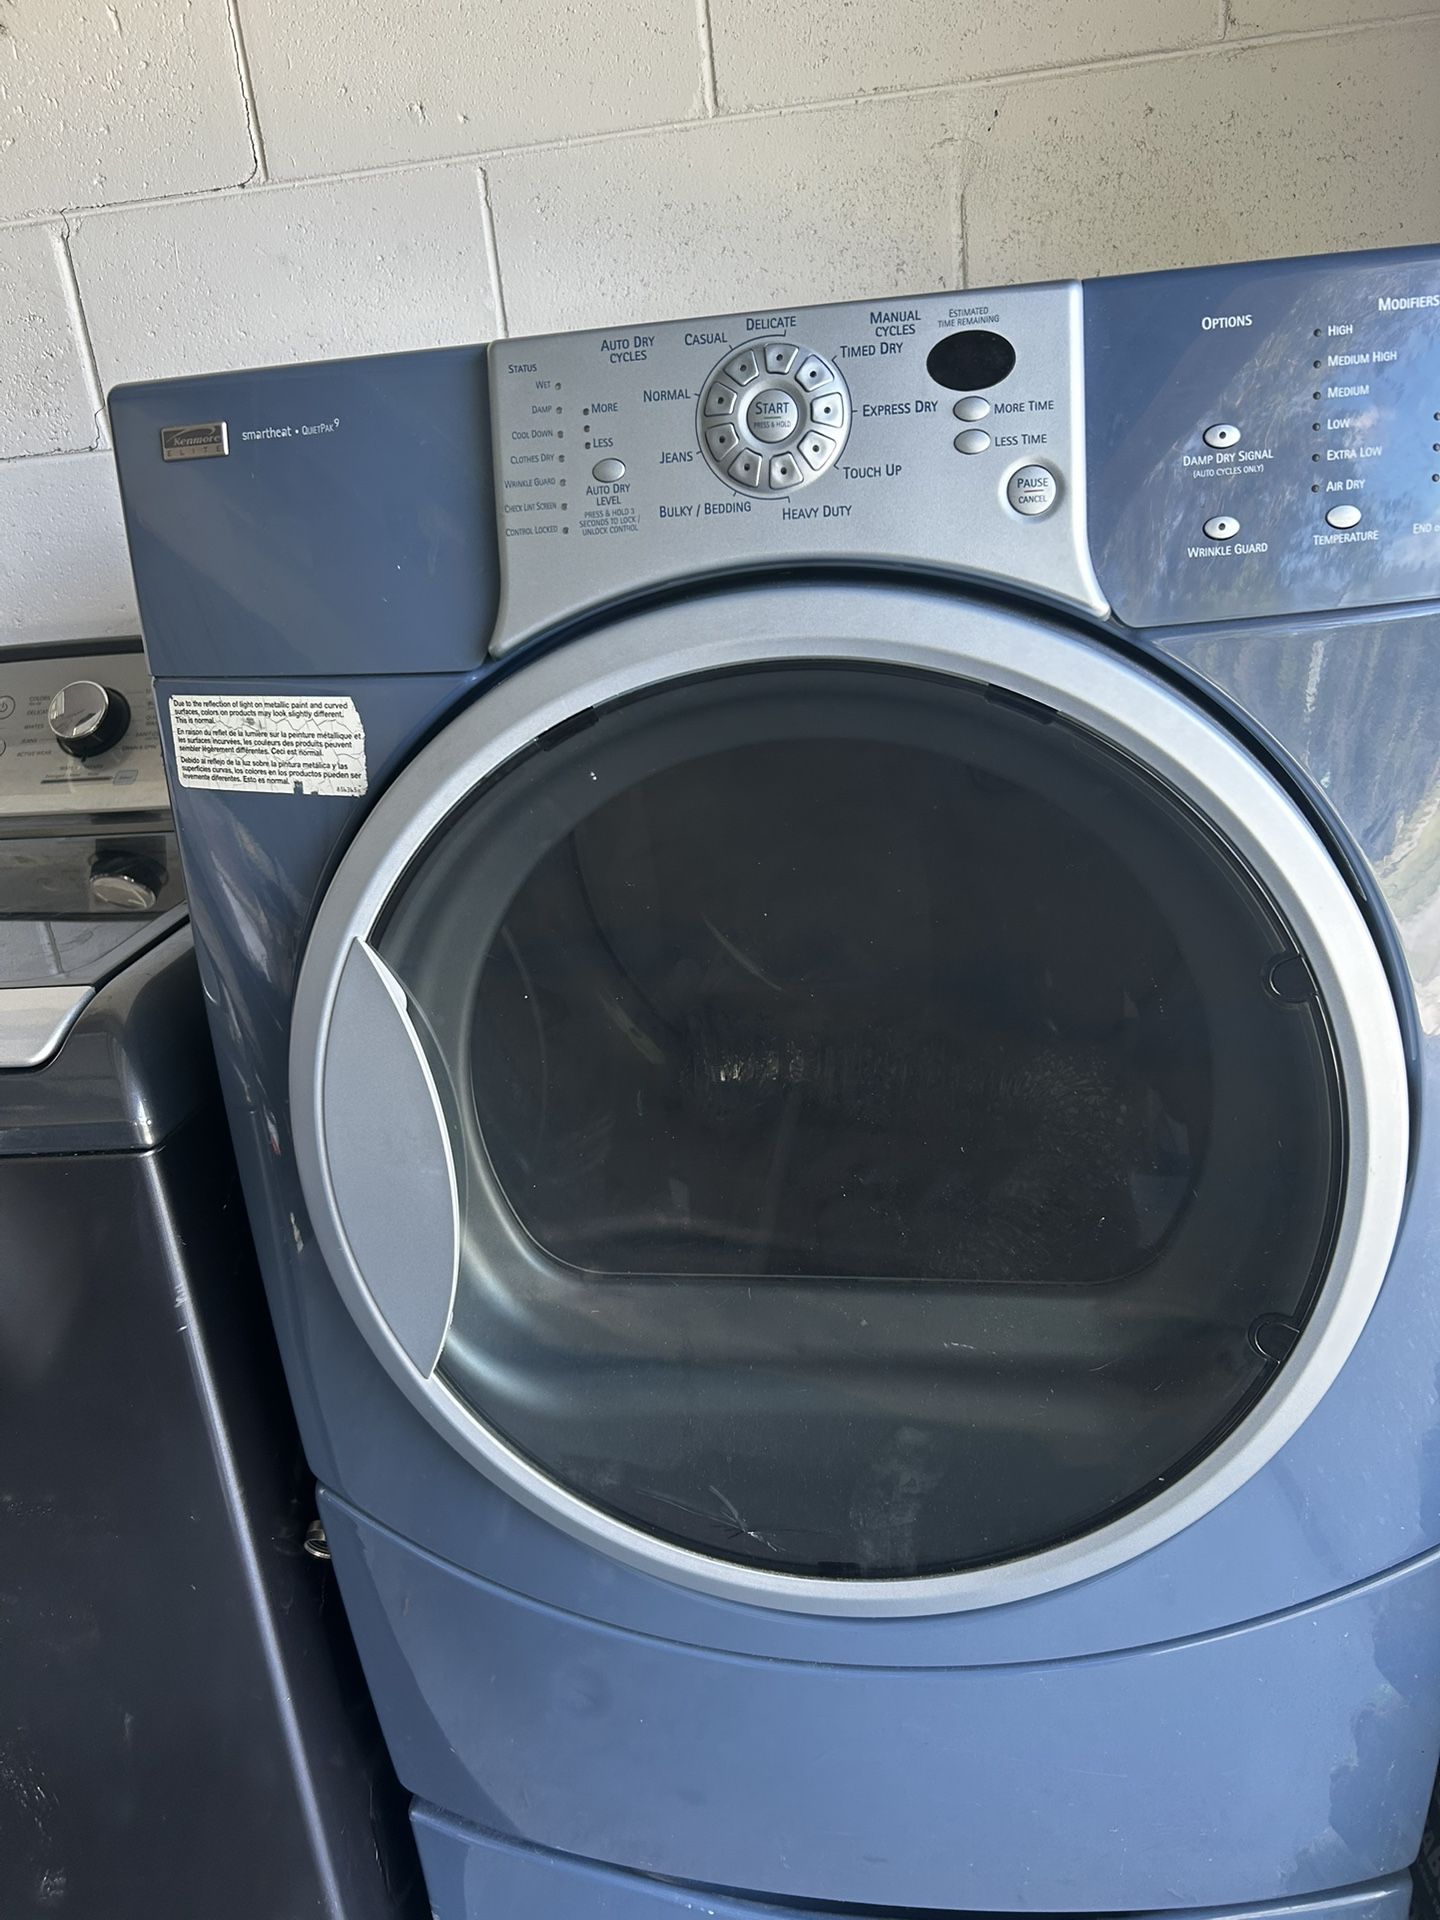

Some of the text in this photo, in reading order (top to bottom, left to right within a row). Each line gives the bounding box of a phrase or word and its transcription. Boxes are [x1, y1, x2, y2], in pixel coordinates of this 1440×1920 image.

[1378, 295, 1440, 311] MODIFIERS
[870, 310, 921, 324] MANUAL
[949, 307, 988, 318] ESTIMATED
[746, 316, 797, 331] DELICATE
[938, 314, 1000, 328] TIME REMAINING
[1202, 314, 1253, 330] OPTIONS
[875, 324, 916, 337] CYCLES
[1328, 324, 1353, 336] HIGH
[601, 336, 655, 352] AUTO DRY
[684, 333, 728, 346] CASUAL
[840, 342, 903, 358] TIMED DRY
[609, 351, 647, 364] CYCLES
[1328, 351, 1397, 367] MEDIUM HIGH
[508, 364, 537, 374] STATUS
[536, 381, 551, 389] WET
[643, 389, 691, 403] NORMAL
[1328, 385, 1370, 398] MEDIUM
[532, 405, 552, 414] DAMP
[591, 403, 619, 413] MORE
[755, 401, 789, 415] START
[863, 400, 938, 417] EXPRESS DRY
[994, 400, 1054, 414] MORE TIME
[776, 420, 791, 428] HOLD
[1327, 419, 1350, 430] LOW
[242, 427, 292, 441] smartheat
[512, 430, 553, 440] COOL DOWN
[995, 433, 1047, 447] LESS TIME
[174, 435, 220, 446] Kenmore
[593, 438, 614, 448] LESS
[510, 454, 555, 464] CLOTHES DRY
[659, 451, 693, 464] JEANS
[1183, 449, 1274, 467] DAMP DRY SIGNAL
[1327, 447, 1382, 461] EXTRA LOW
[843, 464, 902, 479] TOUCH UP
[1193, 464, 1264, 479] (AUTO CYCLES ONLY)
[505, 478, 556, 489] WRINKLE GUARD
[1017, 478, 1048, 488] PAUSE
[1326, 479, 1366, 492] AIR DRY
[586, 483, 631, 496] AUTO DRY
[596, 496, 621, 506] LEVEL
[1018, 495, 1047, 504] CANCEL
[505, 505, 522, 513] CHECK
[536, 502, 557, 511] SCREEN
[584, 510, 604, 518] PRESS
[612, 508, 629, 516] HOLD
[660, 505, 693, 518] BULKY
[704, 501, 751, 515] BEDDING
[782, 505, 852, 520] HEAVY DUTY
[580, 519, 609, 528] SECONDS
[620, 516, 636, 524] LOCK
[506, 526, 558, 537] CONTROL LOCKED
[582, 525, 638, 536] UNLOCK CONTROL
[1413, 523, 1432, 534] END
[1313, 530, 1379, 546] TEMPERATURE
[1187, 543, 1268, 558] WRINKLE GUARD
[203, 700, 231, 708] reflection
[239, 701, 253, 709] light
[291, 702, 308, 711] paint
[288, 710, 312, 718] slightly
[317, 732, 352, 740] métallique
[295, 740, 323, 748] produits
[324, 741, 352, 749] peuvent
[271, 747, 285, 755] Ceci
[181, 756, 200, 764] Debido
[207, 758, 225, 766] reflejo
[323, 771, 349, 779] pueden
